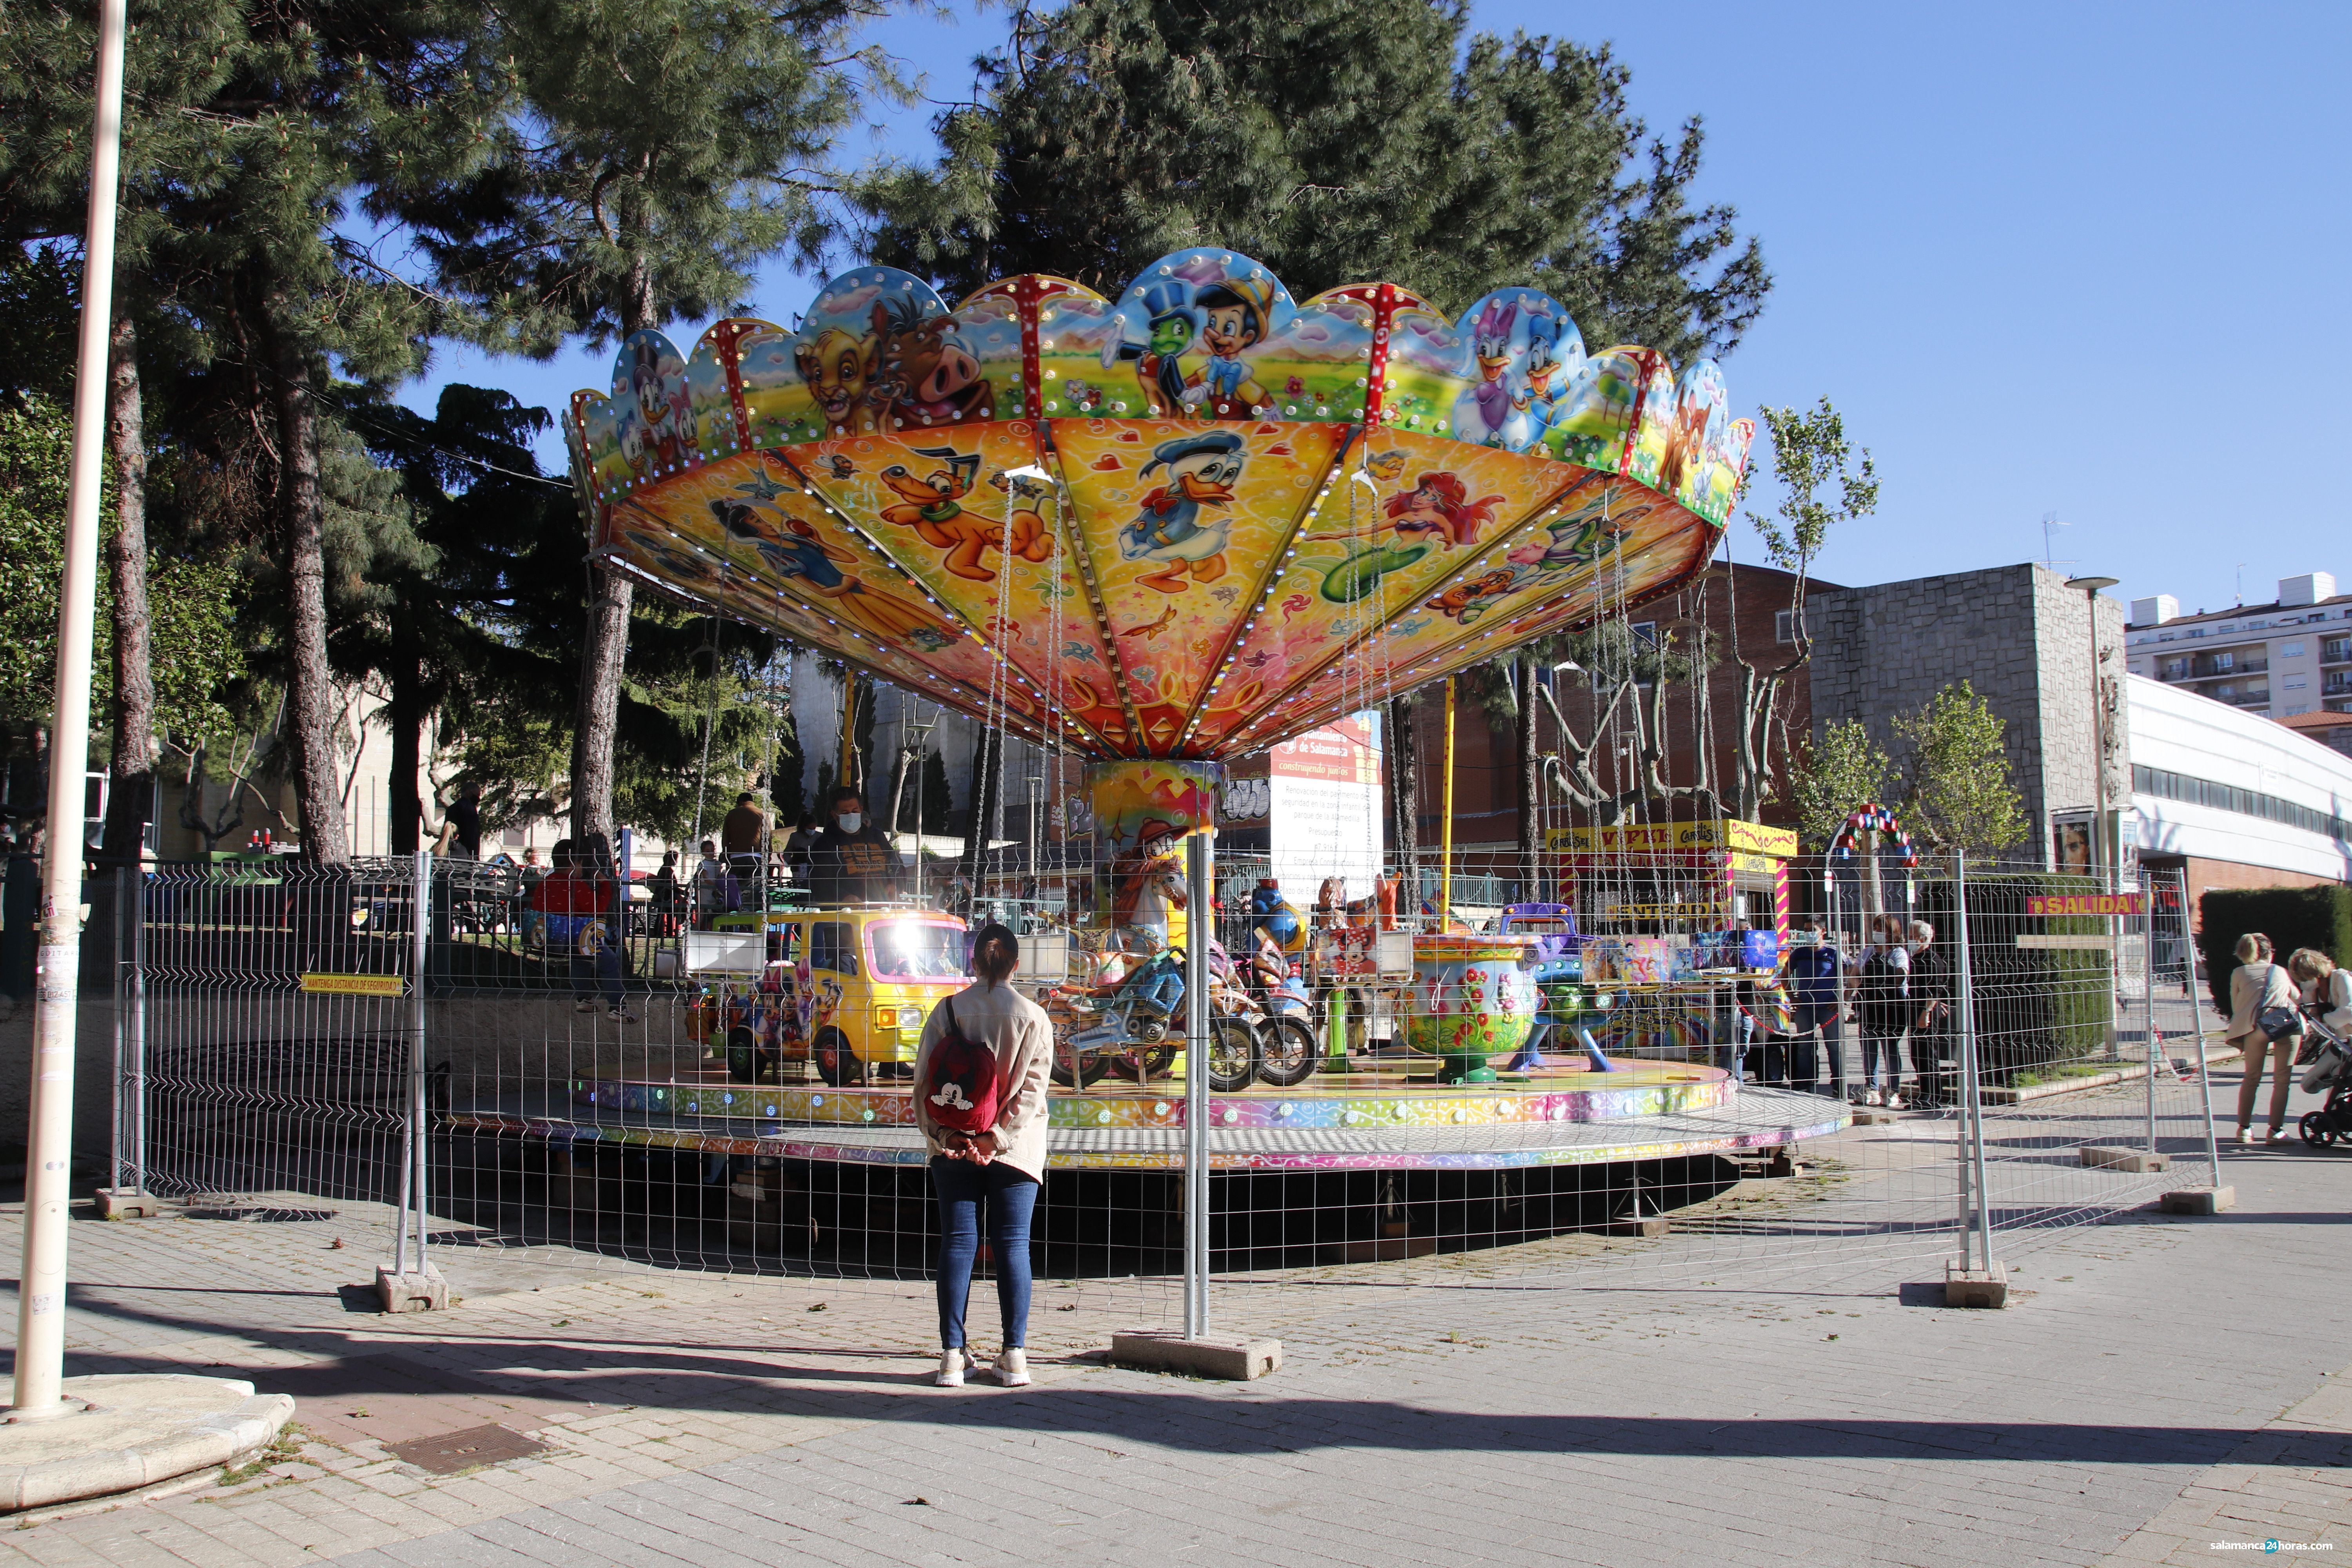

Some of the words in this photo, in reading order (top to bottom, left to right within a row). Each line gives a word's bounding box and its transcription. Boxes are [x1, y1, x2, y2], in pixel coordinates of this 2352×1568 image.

[1299, 741, 1308, 753] de
[1310, 742, 1348, 757] Salamanca
[1279, 762, 1326, 776] construyendo
[1327, 765, 1348, 778] juntos
[1320, 789, 1328, 797] del
[1330, 790, 1359, 800] pavimento
[1281, 798, 1310, 808] seguridad
[1320, 800, 1325, 809] la
[1341, 802, 1361, 812] infantil
[1294, 811, 1314, 820] parque
[1331, 813, 1360, 823] Alamedilla
[1308, 827, 1342, 837] Presupuesto
[1616, 903, 1723, 918] ENTRADA
[2047, 897, 2130, 914] SALIDA
[307, 978, 334, 989] MANTENGA
[334, 979, 359, 990] DISTANCIA
[359, 980, 367, 990] DE
[367, 980, 396, 991] SEGURIDAD
